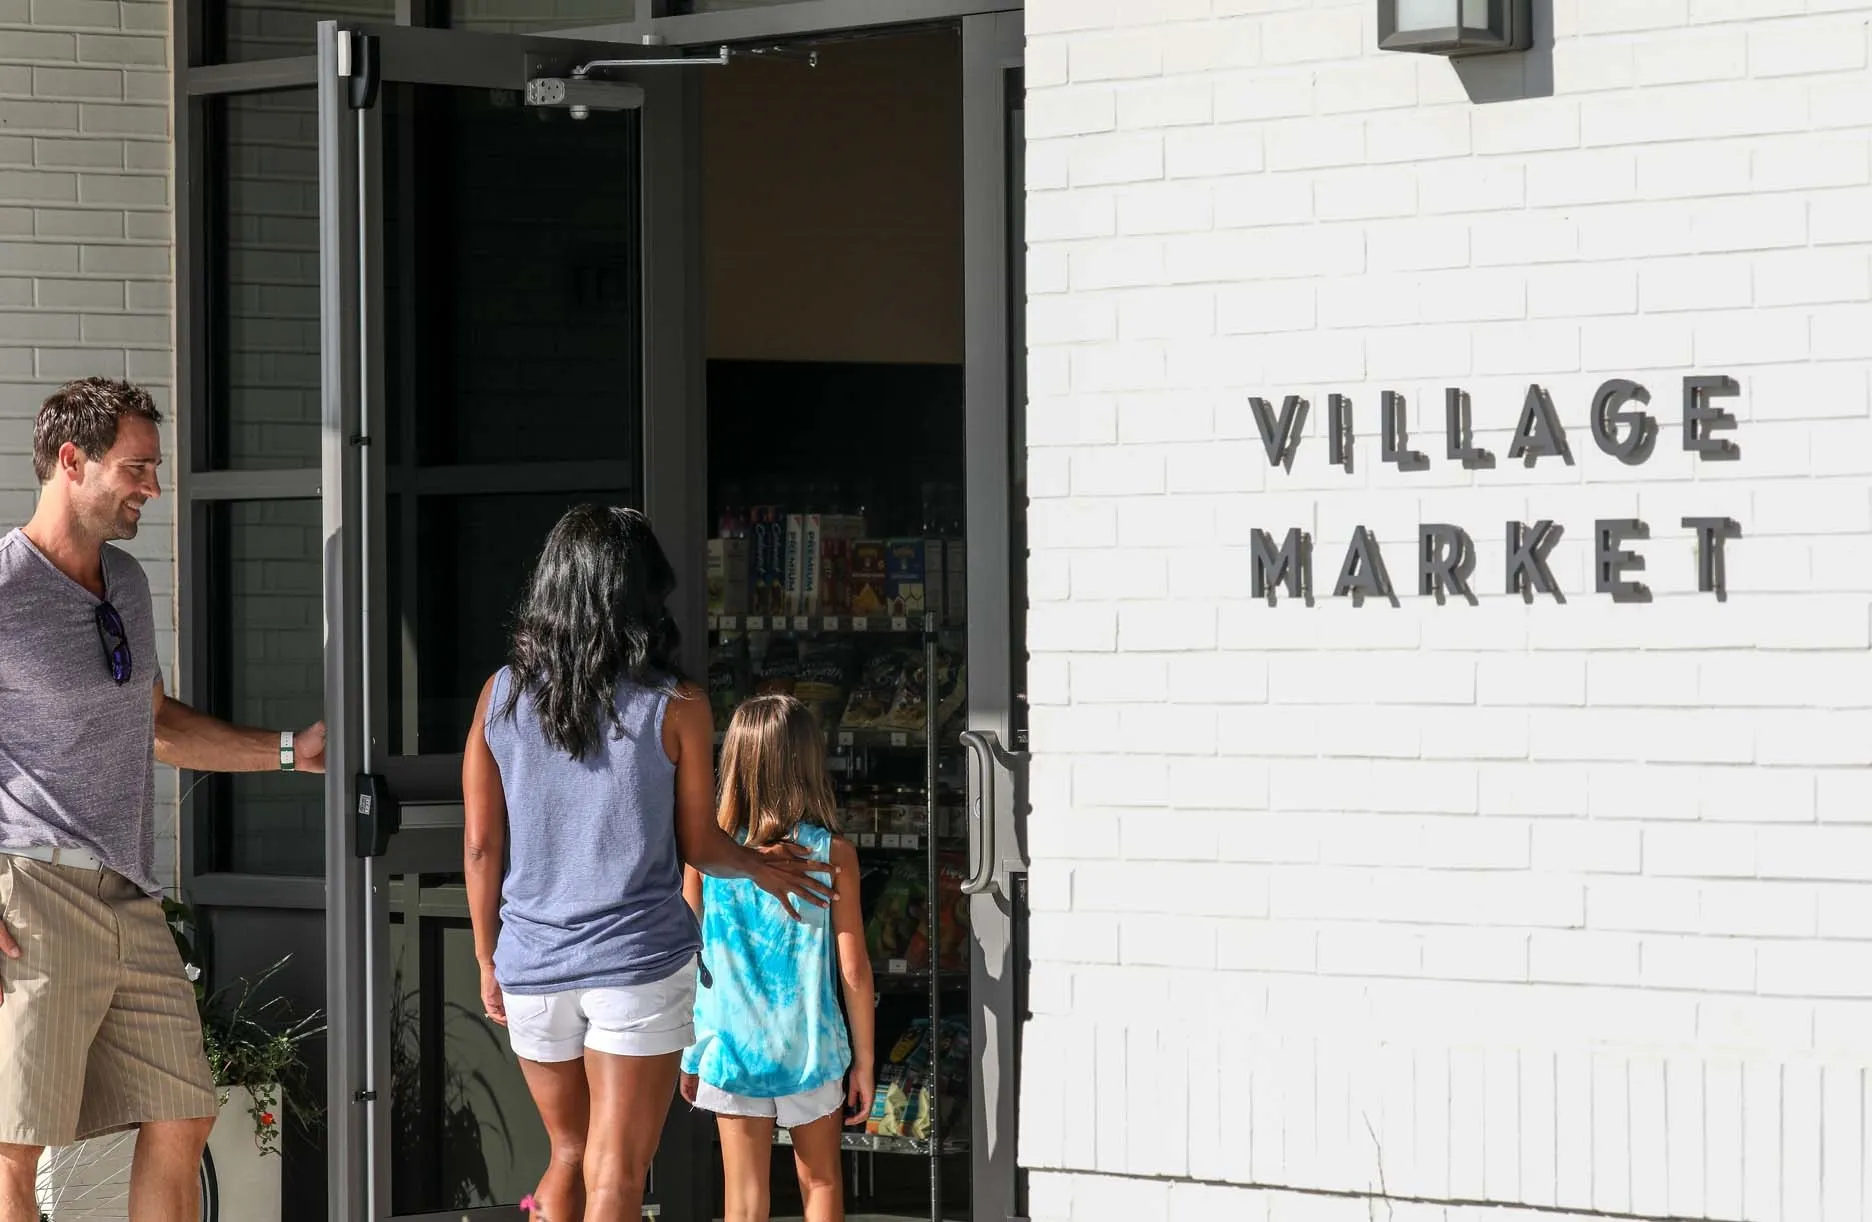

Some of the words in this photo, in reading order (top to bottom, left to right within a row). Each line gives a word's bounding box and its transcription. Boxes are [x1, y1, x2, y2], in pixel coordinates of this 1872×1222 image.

[1248, 376, 1740, 473] VILLAGE
[787, 531, 797, 592] PREMIUM
[805, 531, 815, 592] PREMIUM
[1249, 517, 1742, 606] MARKET
